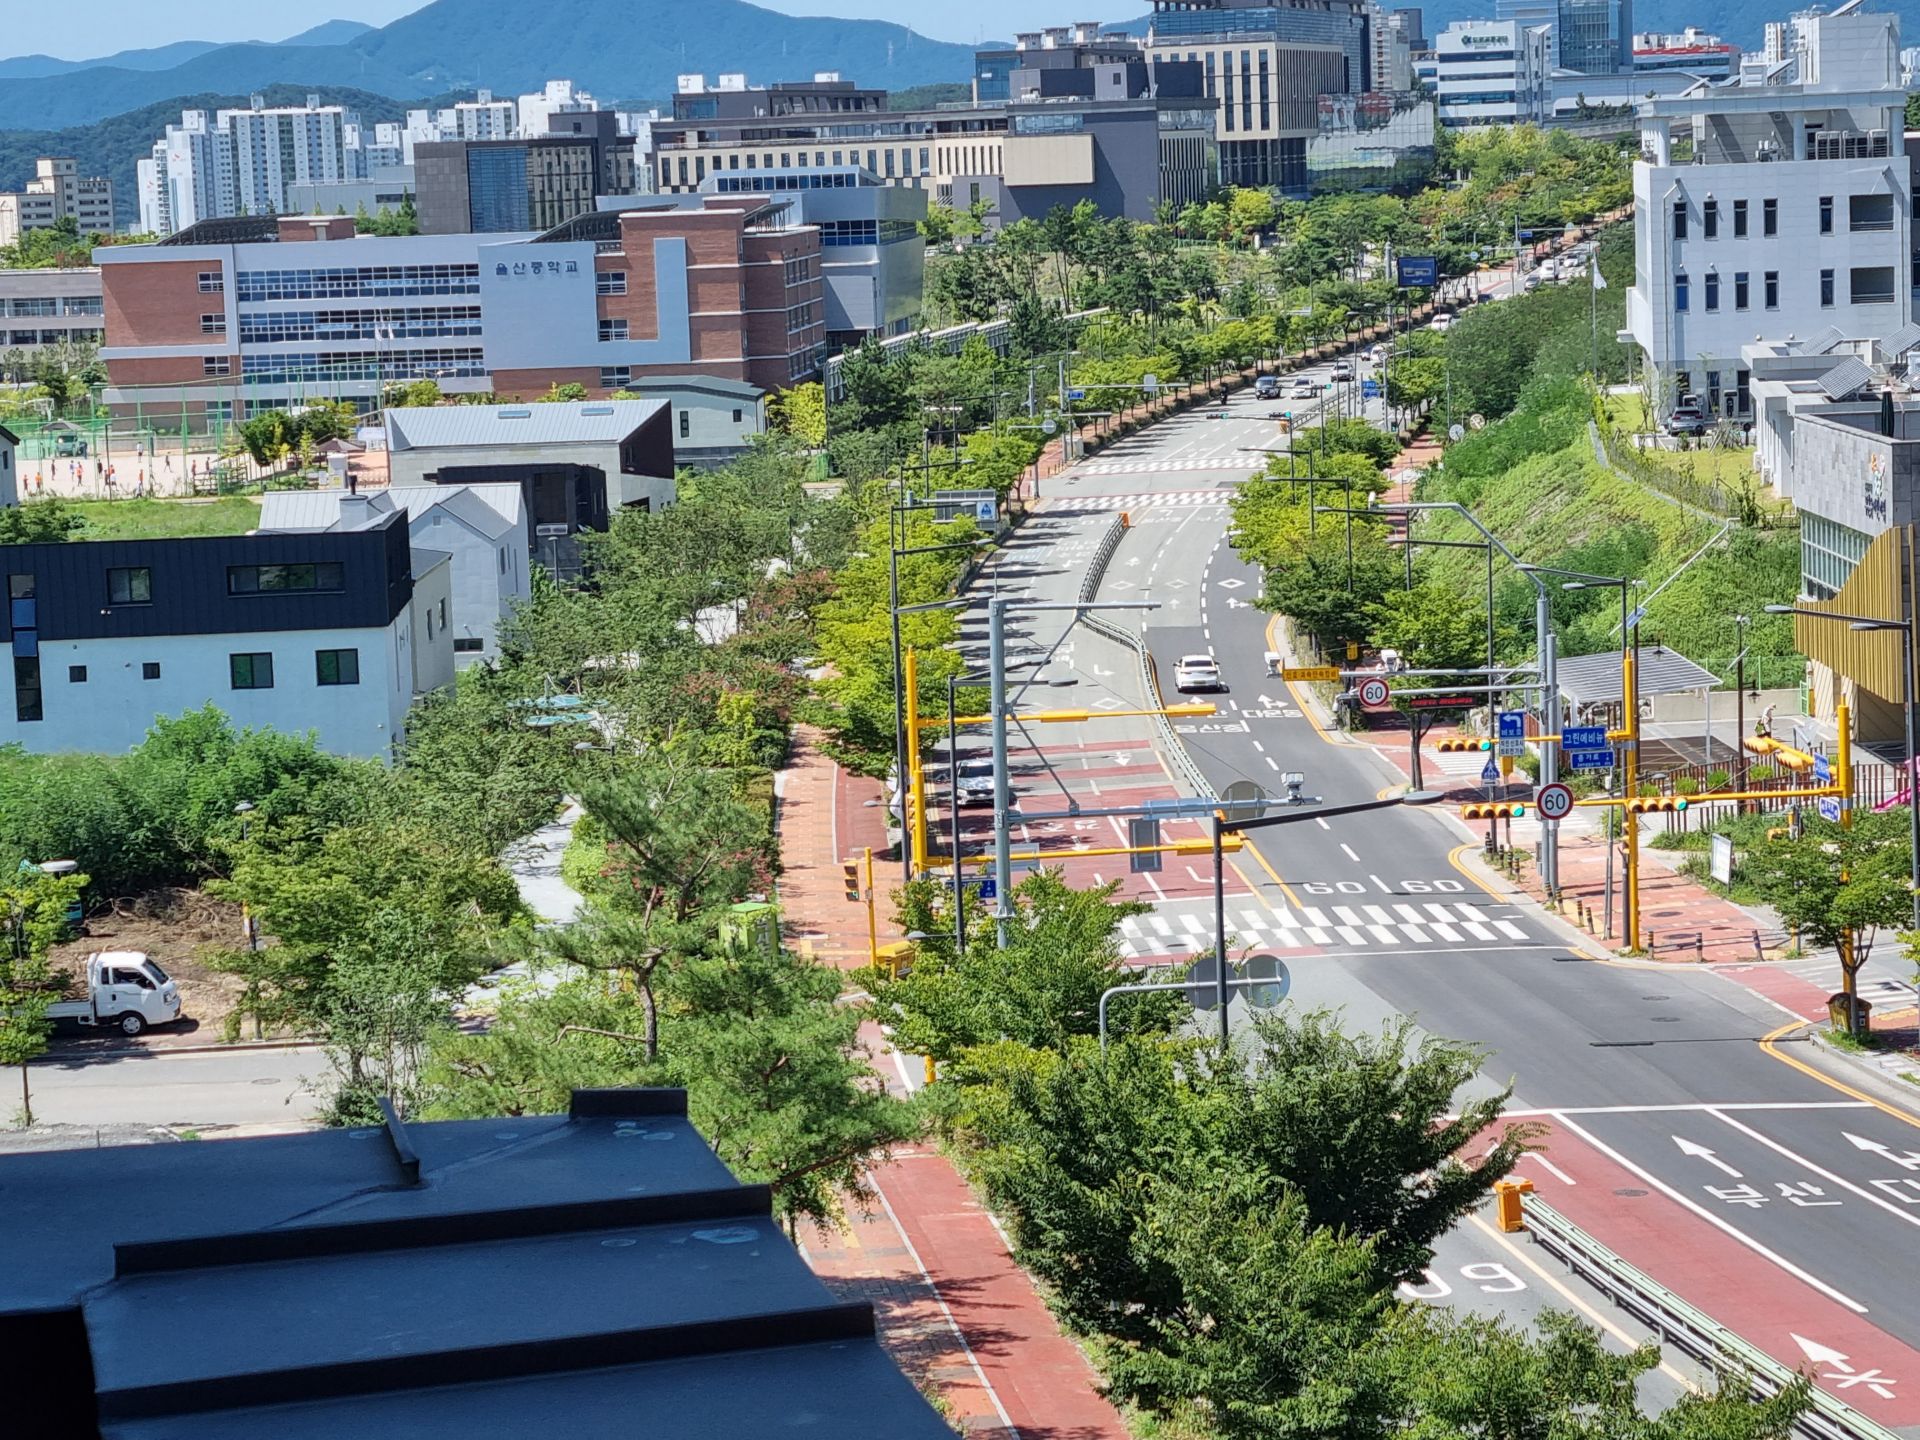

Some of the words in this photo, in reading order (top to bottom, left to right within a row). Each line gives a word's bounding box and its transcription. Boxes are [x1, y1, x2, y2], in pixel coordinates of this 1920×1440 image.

[496, 260, 578, 275] 울산중학교
[1365, 686, 1383, 700] 60
[1545, 793, 1566, 810] 60
[1303, 881, 1367, 894] 60
[1401, 879, 1465, 893] 60
[1703, 1182, 1843, 1208] 부산
